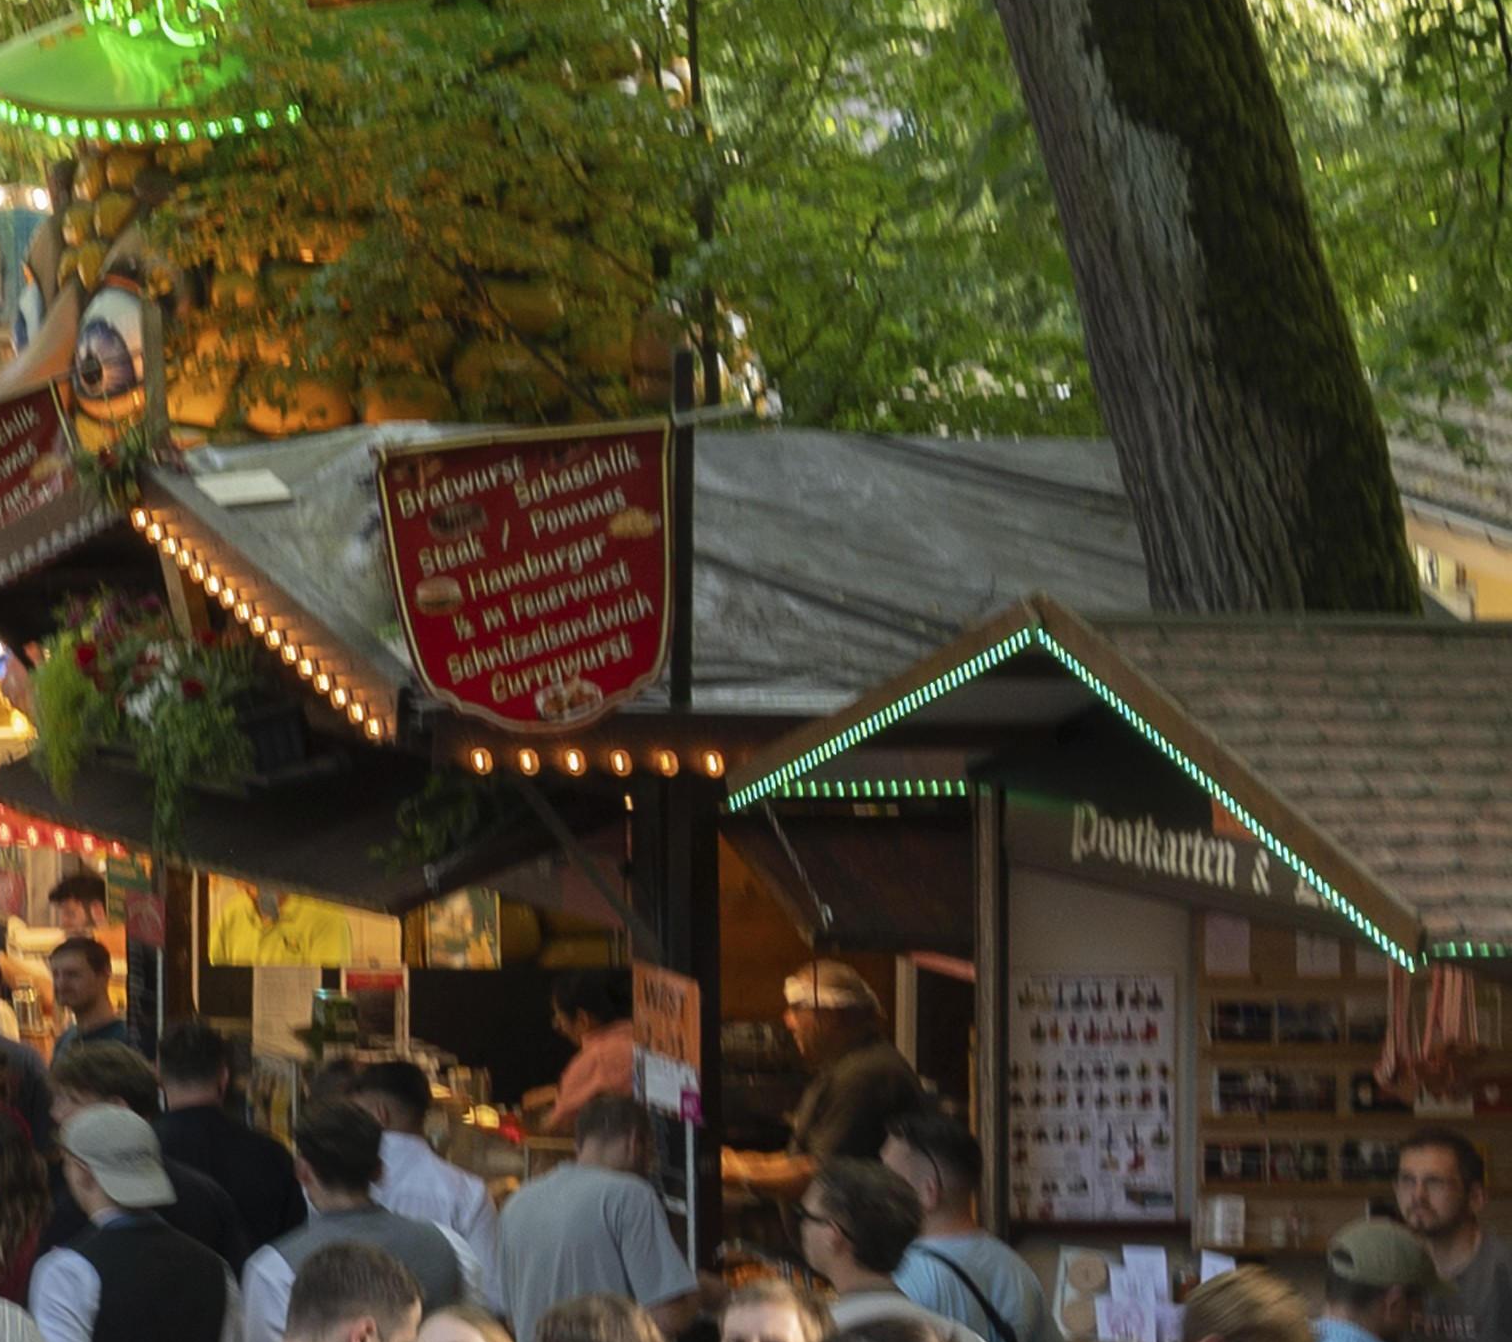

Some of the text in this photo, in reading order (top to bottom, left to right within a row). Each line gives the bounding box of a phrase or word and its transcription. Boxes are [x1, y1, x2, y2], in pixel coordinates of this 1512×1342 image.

[396, 453, 526, 519] Bratwurst
[514, 442, 641, 508] Schaschlik
[418, 531, 485, 578] Steak
[529, 486, 627, 539] Pommes
[467, 533, 607, 601] Hamburger
[511, 561, 632, 623] Feuerwurst
[446, 589, 654, 686] Schnitzelsandwich
[490, 632, 633, 704] Currywurst
